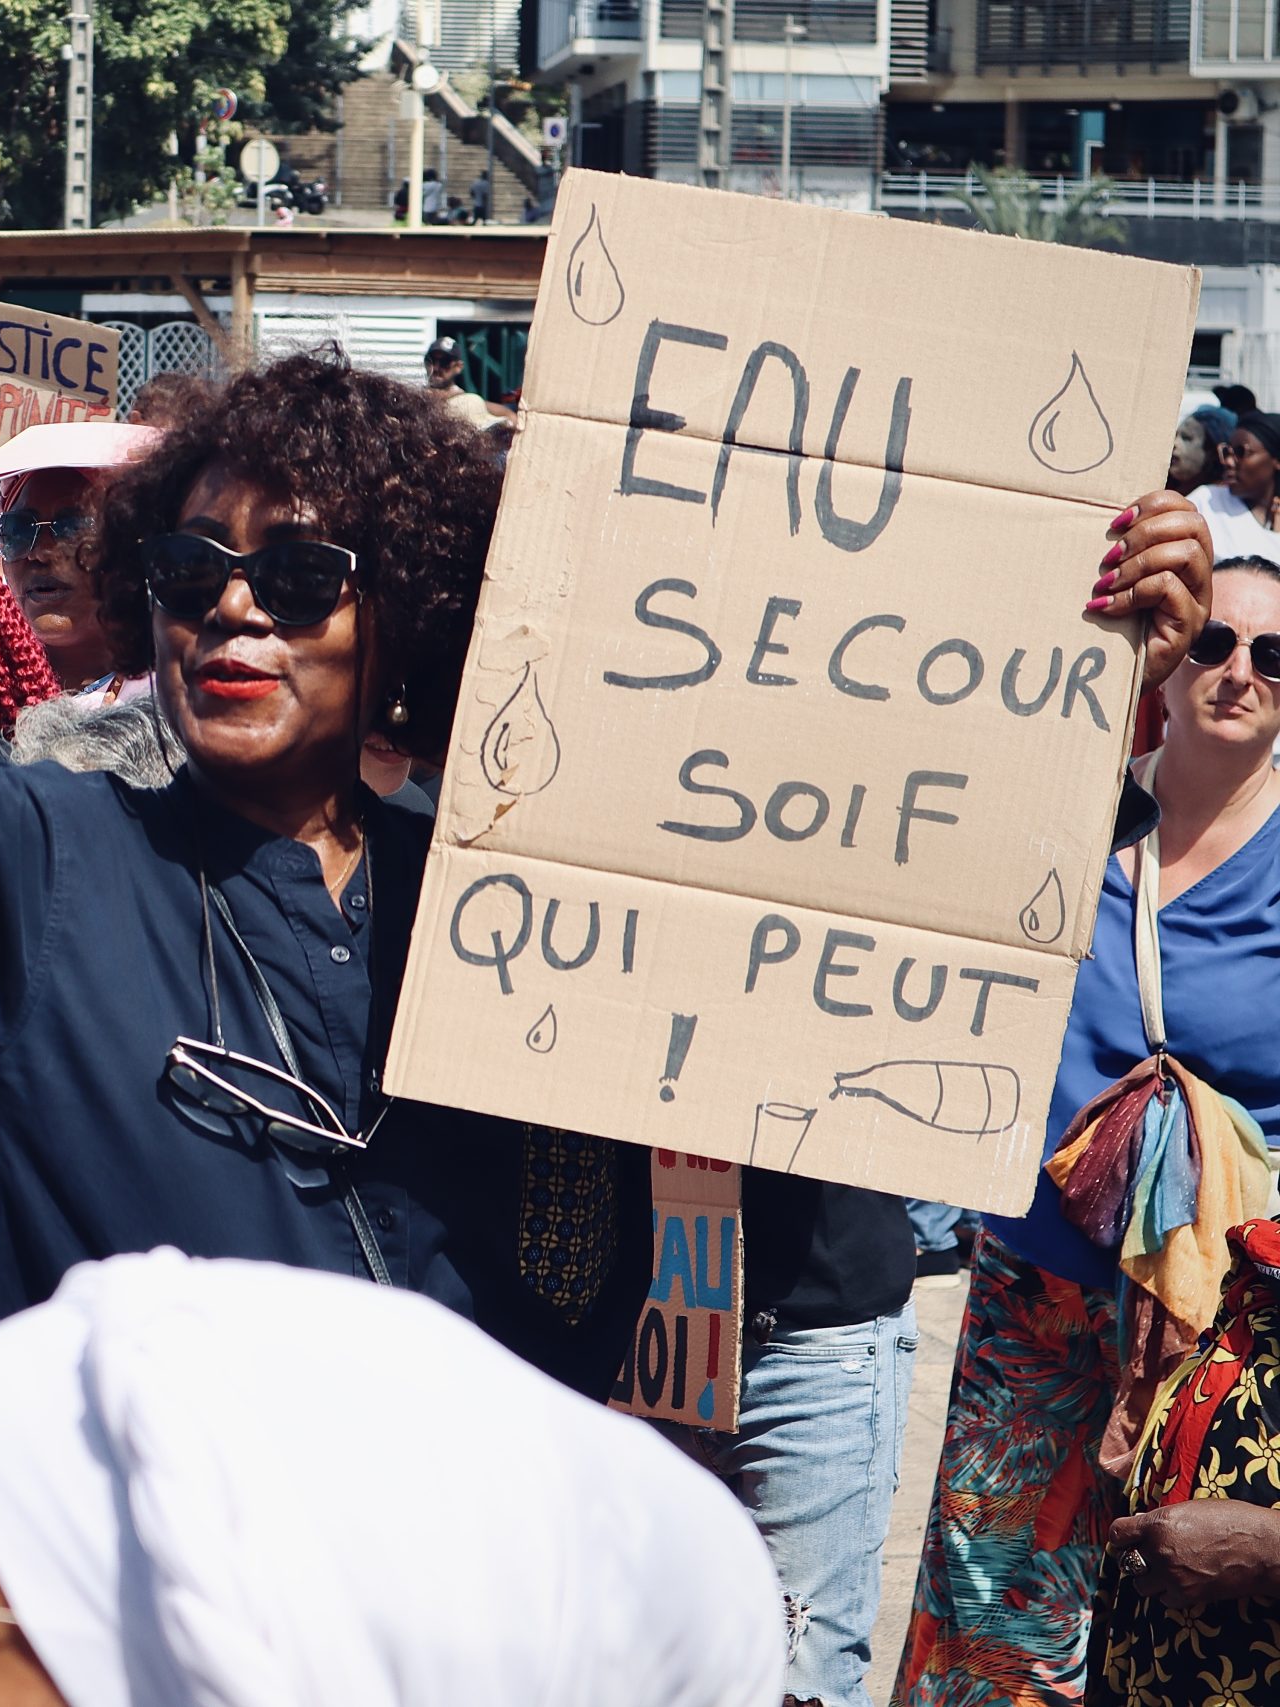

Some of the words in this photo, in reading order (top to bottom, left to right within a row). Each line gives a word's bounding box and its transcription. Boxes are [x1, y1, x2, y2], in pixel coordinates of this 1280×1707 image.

[617, 318, 913, 553] EAU
[604, 578, 1110, 733] SECOUR
[657, 749, 969, 866] SOIF
[450, 873, 639, 995] QUI
[745, 913, 1039, 1036] PEUT
[659, 1013, 698, 1102] !
[650, 1208, 735, 1312] AU
